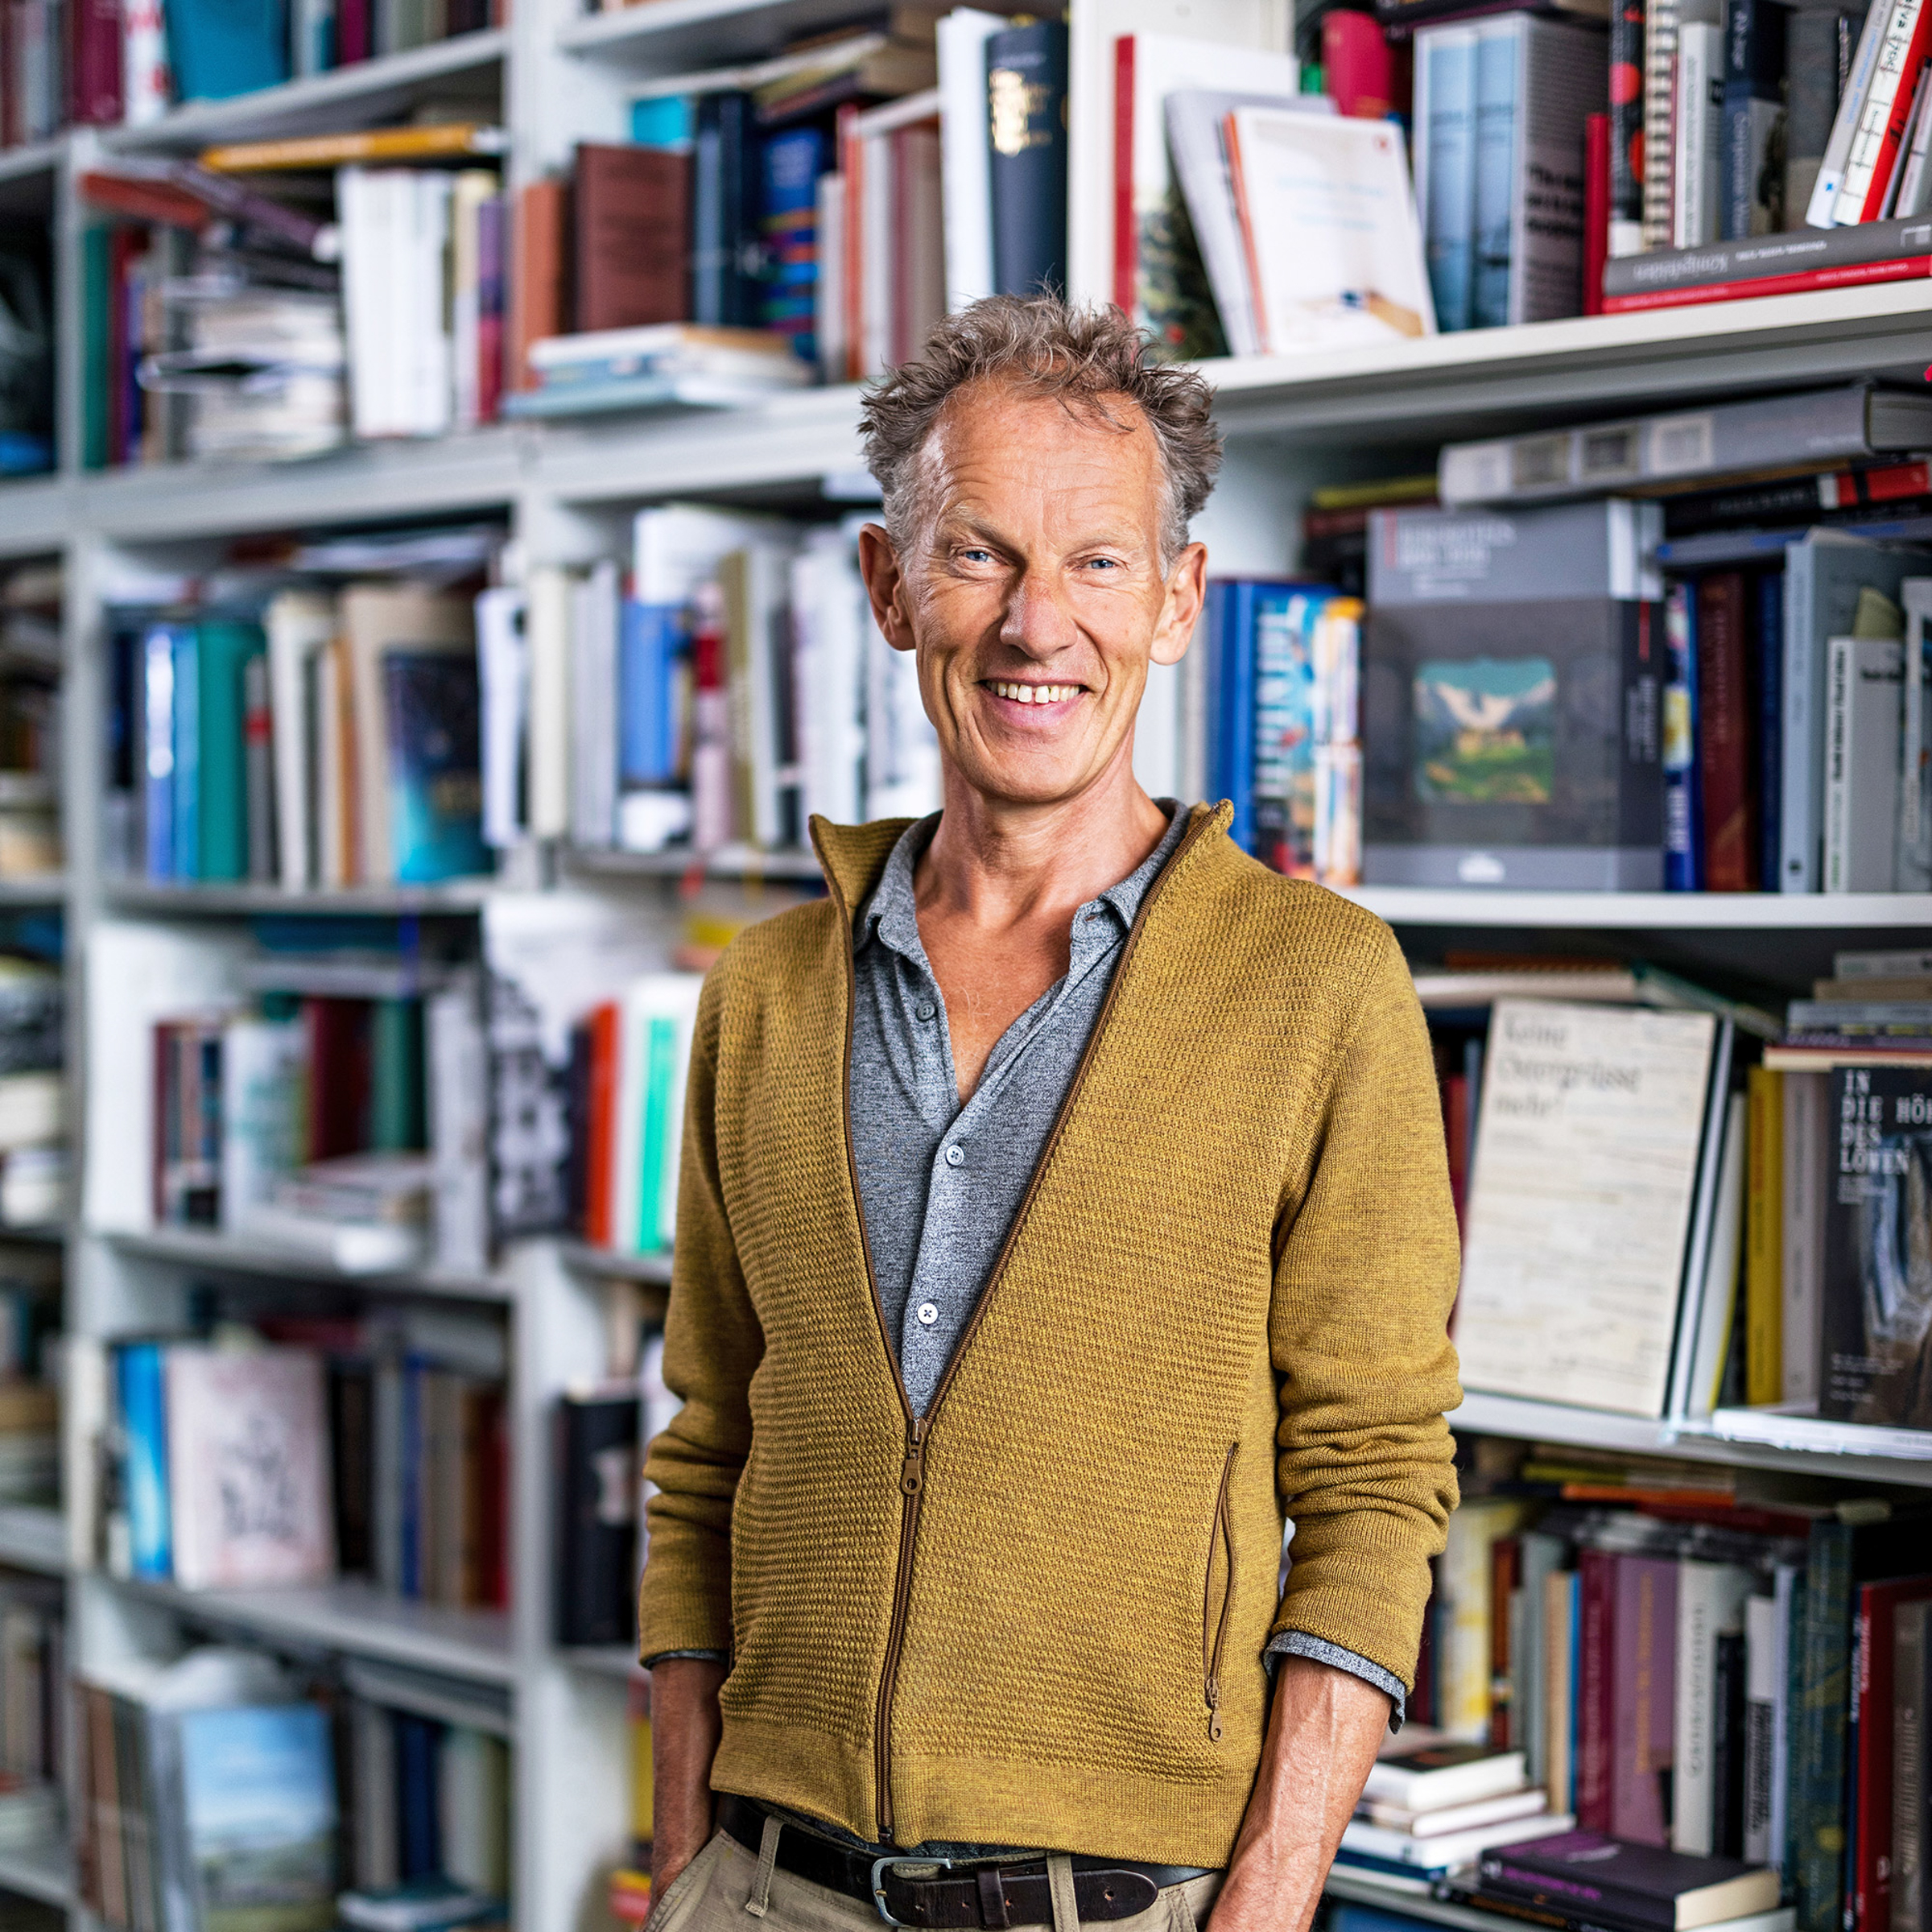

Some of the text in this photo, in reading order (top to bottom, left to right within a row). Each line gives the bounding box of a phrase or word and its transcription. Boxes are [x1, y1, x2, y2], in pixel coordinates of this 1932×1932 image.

[1845, 1068, 1871, 1096] IN
[1841, 1096, 1884, 1122] DIE
[1840, 1121, 1882, 1149] DES
